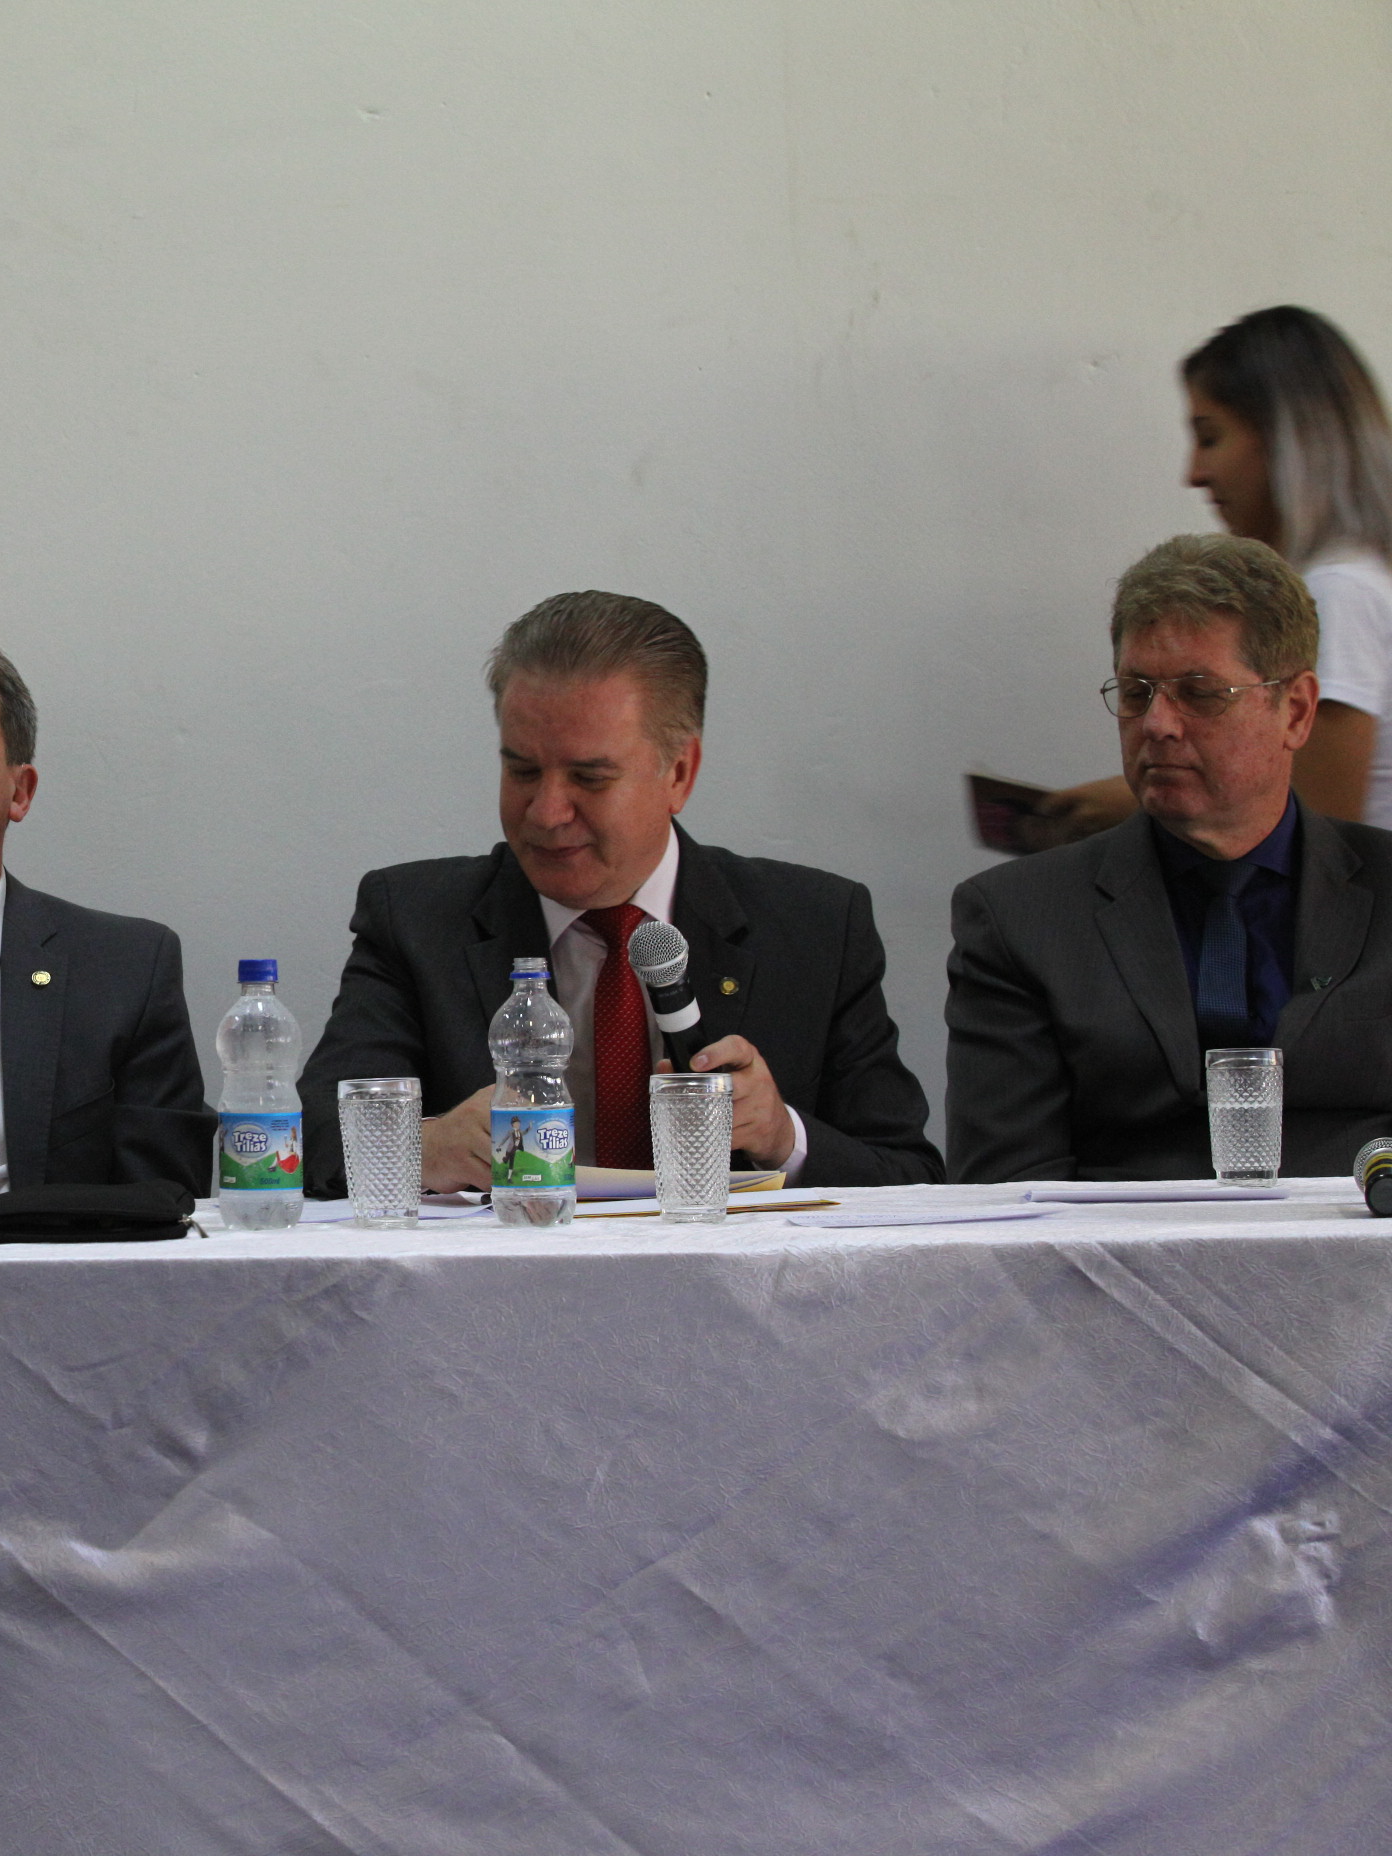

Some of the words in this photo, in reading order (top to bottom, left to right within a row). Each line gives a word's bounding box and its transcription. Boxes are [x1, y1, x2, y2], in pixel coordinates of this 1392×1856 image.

[233, 1131, 267, 1142] Treze
[537, 1128, 568, 1139] Treze
[235, 1140, 267, 1152] Tílias
[541, 1137, 568, 1149] Tílias
